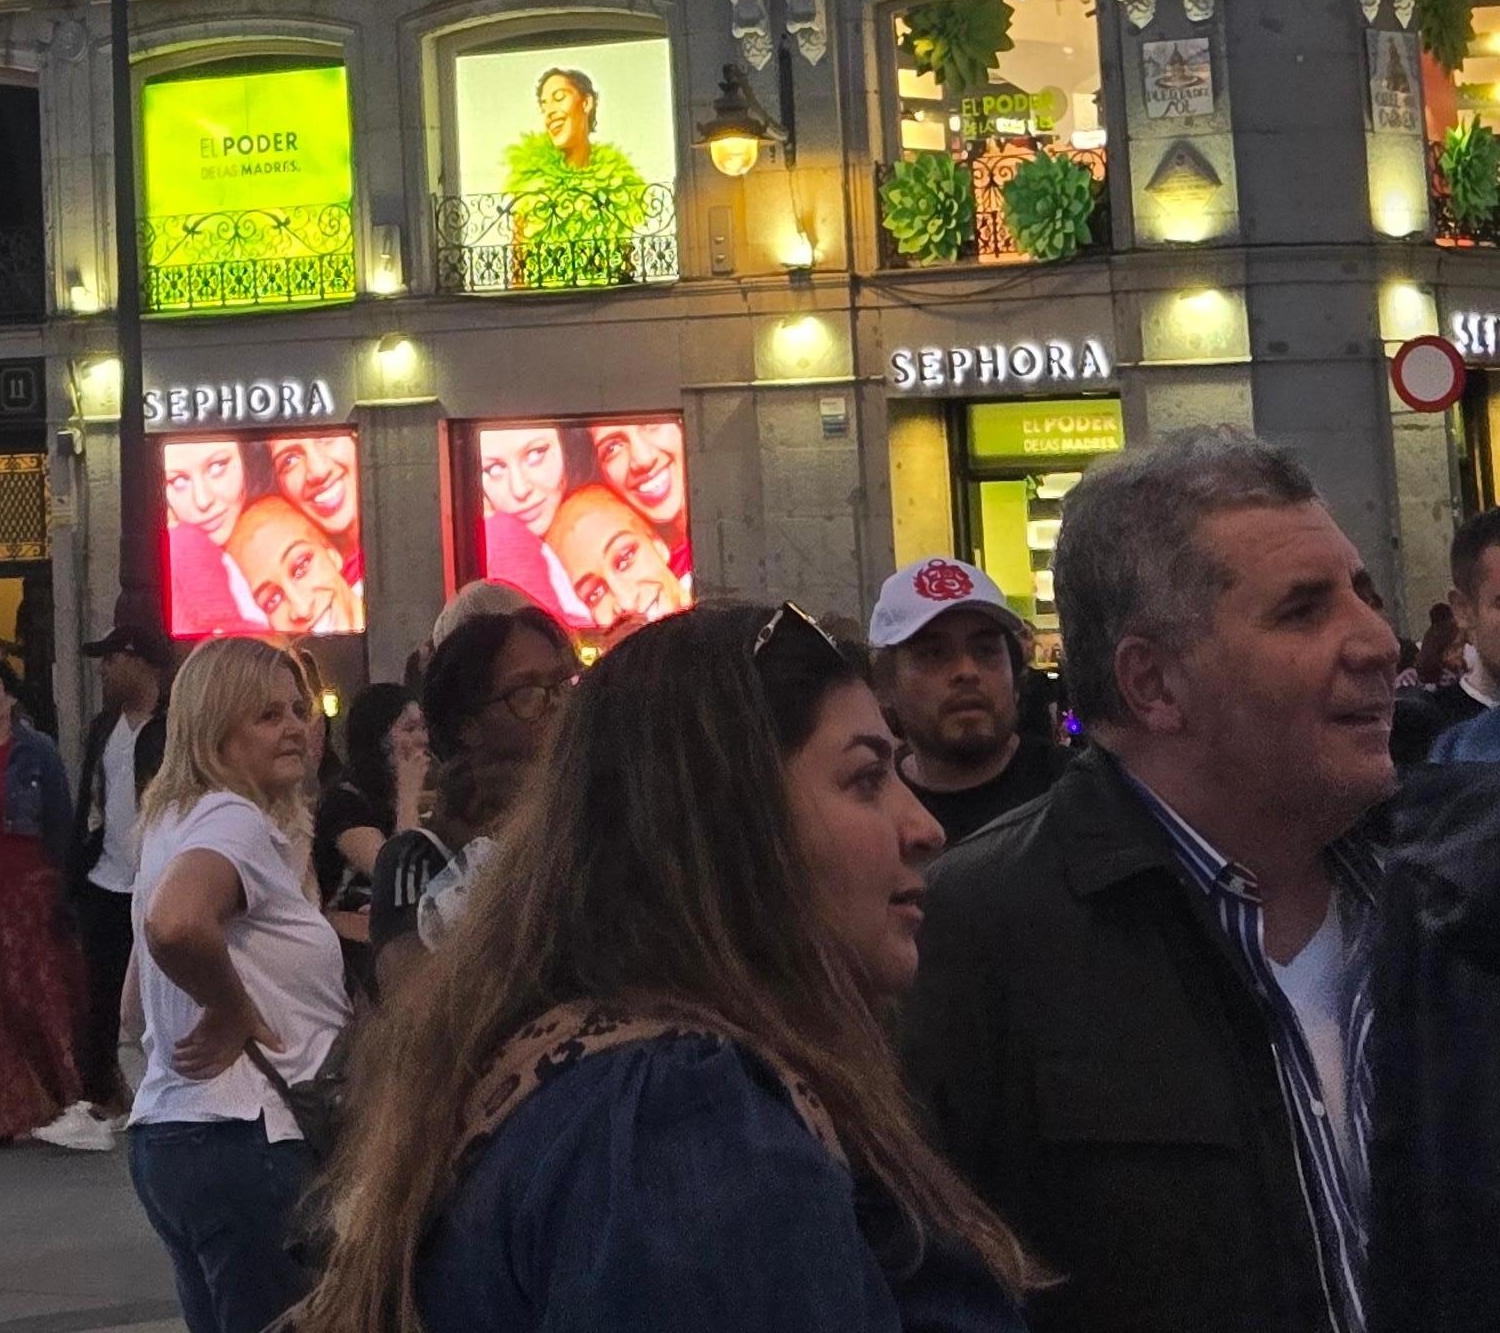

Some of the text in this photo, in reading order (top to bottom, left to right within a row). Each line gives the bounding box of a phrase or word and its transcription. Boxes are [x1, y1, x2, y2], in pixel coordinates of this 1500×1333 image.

[962, 98, 979, 117] EL
[200, 132, 298, 158] EL PODER
[891, 341, 1111, 388] SEPHORA
[10, 378, 24, 399] 11
[144, 379, 334, 423] SEPHORA
[1023, 416, 1117, 434] EL PODER
